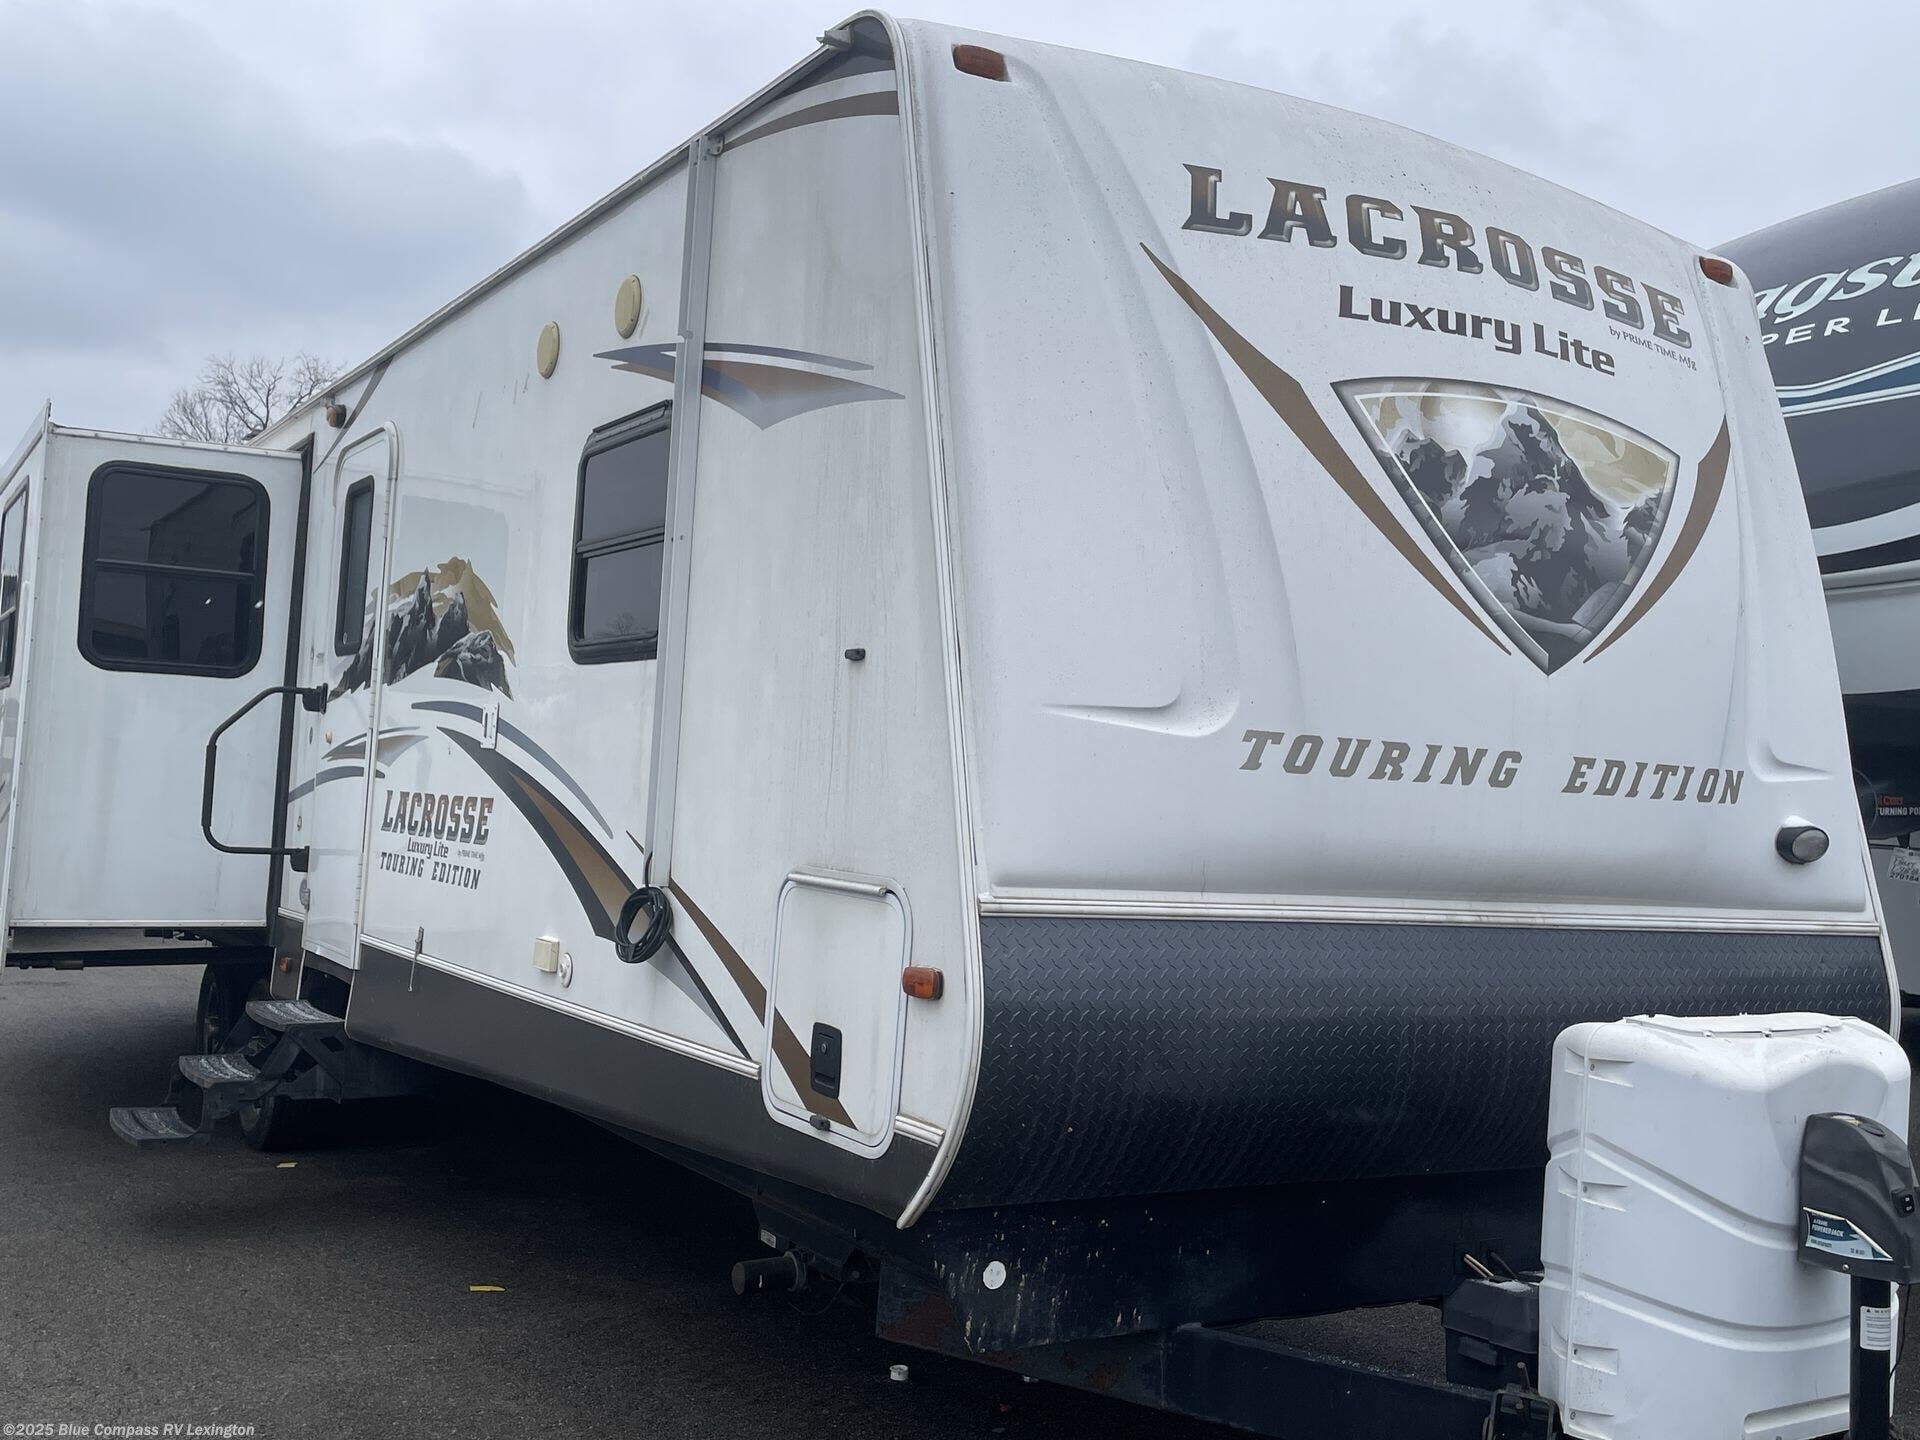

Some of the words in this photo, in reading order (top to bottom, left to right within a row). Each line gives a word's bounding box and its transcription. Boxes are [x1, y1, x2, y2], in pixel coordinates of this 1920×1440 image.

[1182, 163, 1692, 349] LACROSSE
[1338, 285, 1522, 355] Luxury
[1533, 321, 1616, 376] Lite
[1609, 325, 1621, 340] by
[1622, 331, 1653, 350] PRIME
[1654, 343, 1678, 360] TIME
[1239, 729, 1523, 789] TOURING
[1561, 755, 1744, 804] EDITION
[381, 790, 494, 845] LACROSSE
[380, 852, 425, 878] TOURING
[431, 861, 481, 890] EDITION
[407, 837, 433, 859] Luxury
[433, 842, 449, 858] Lite
